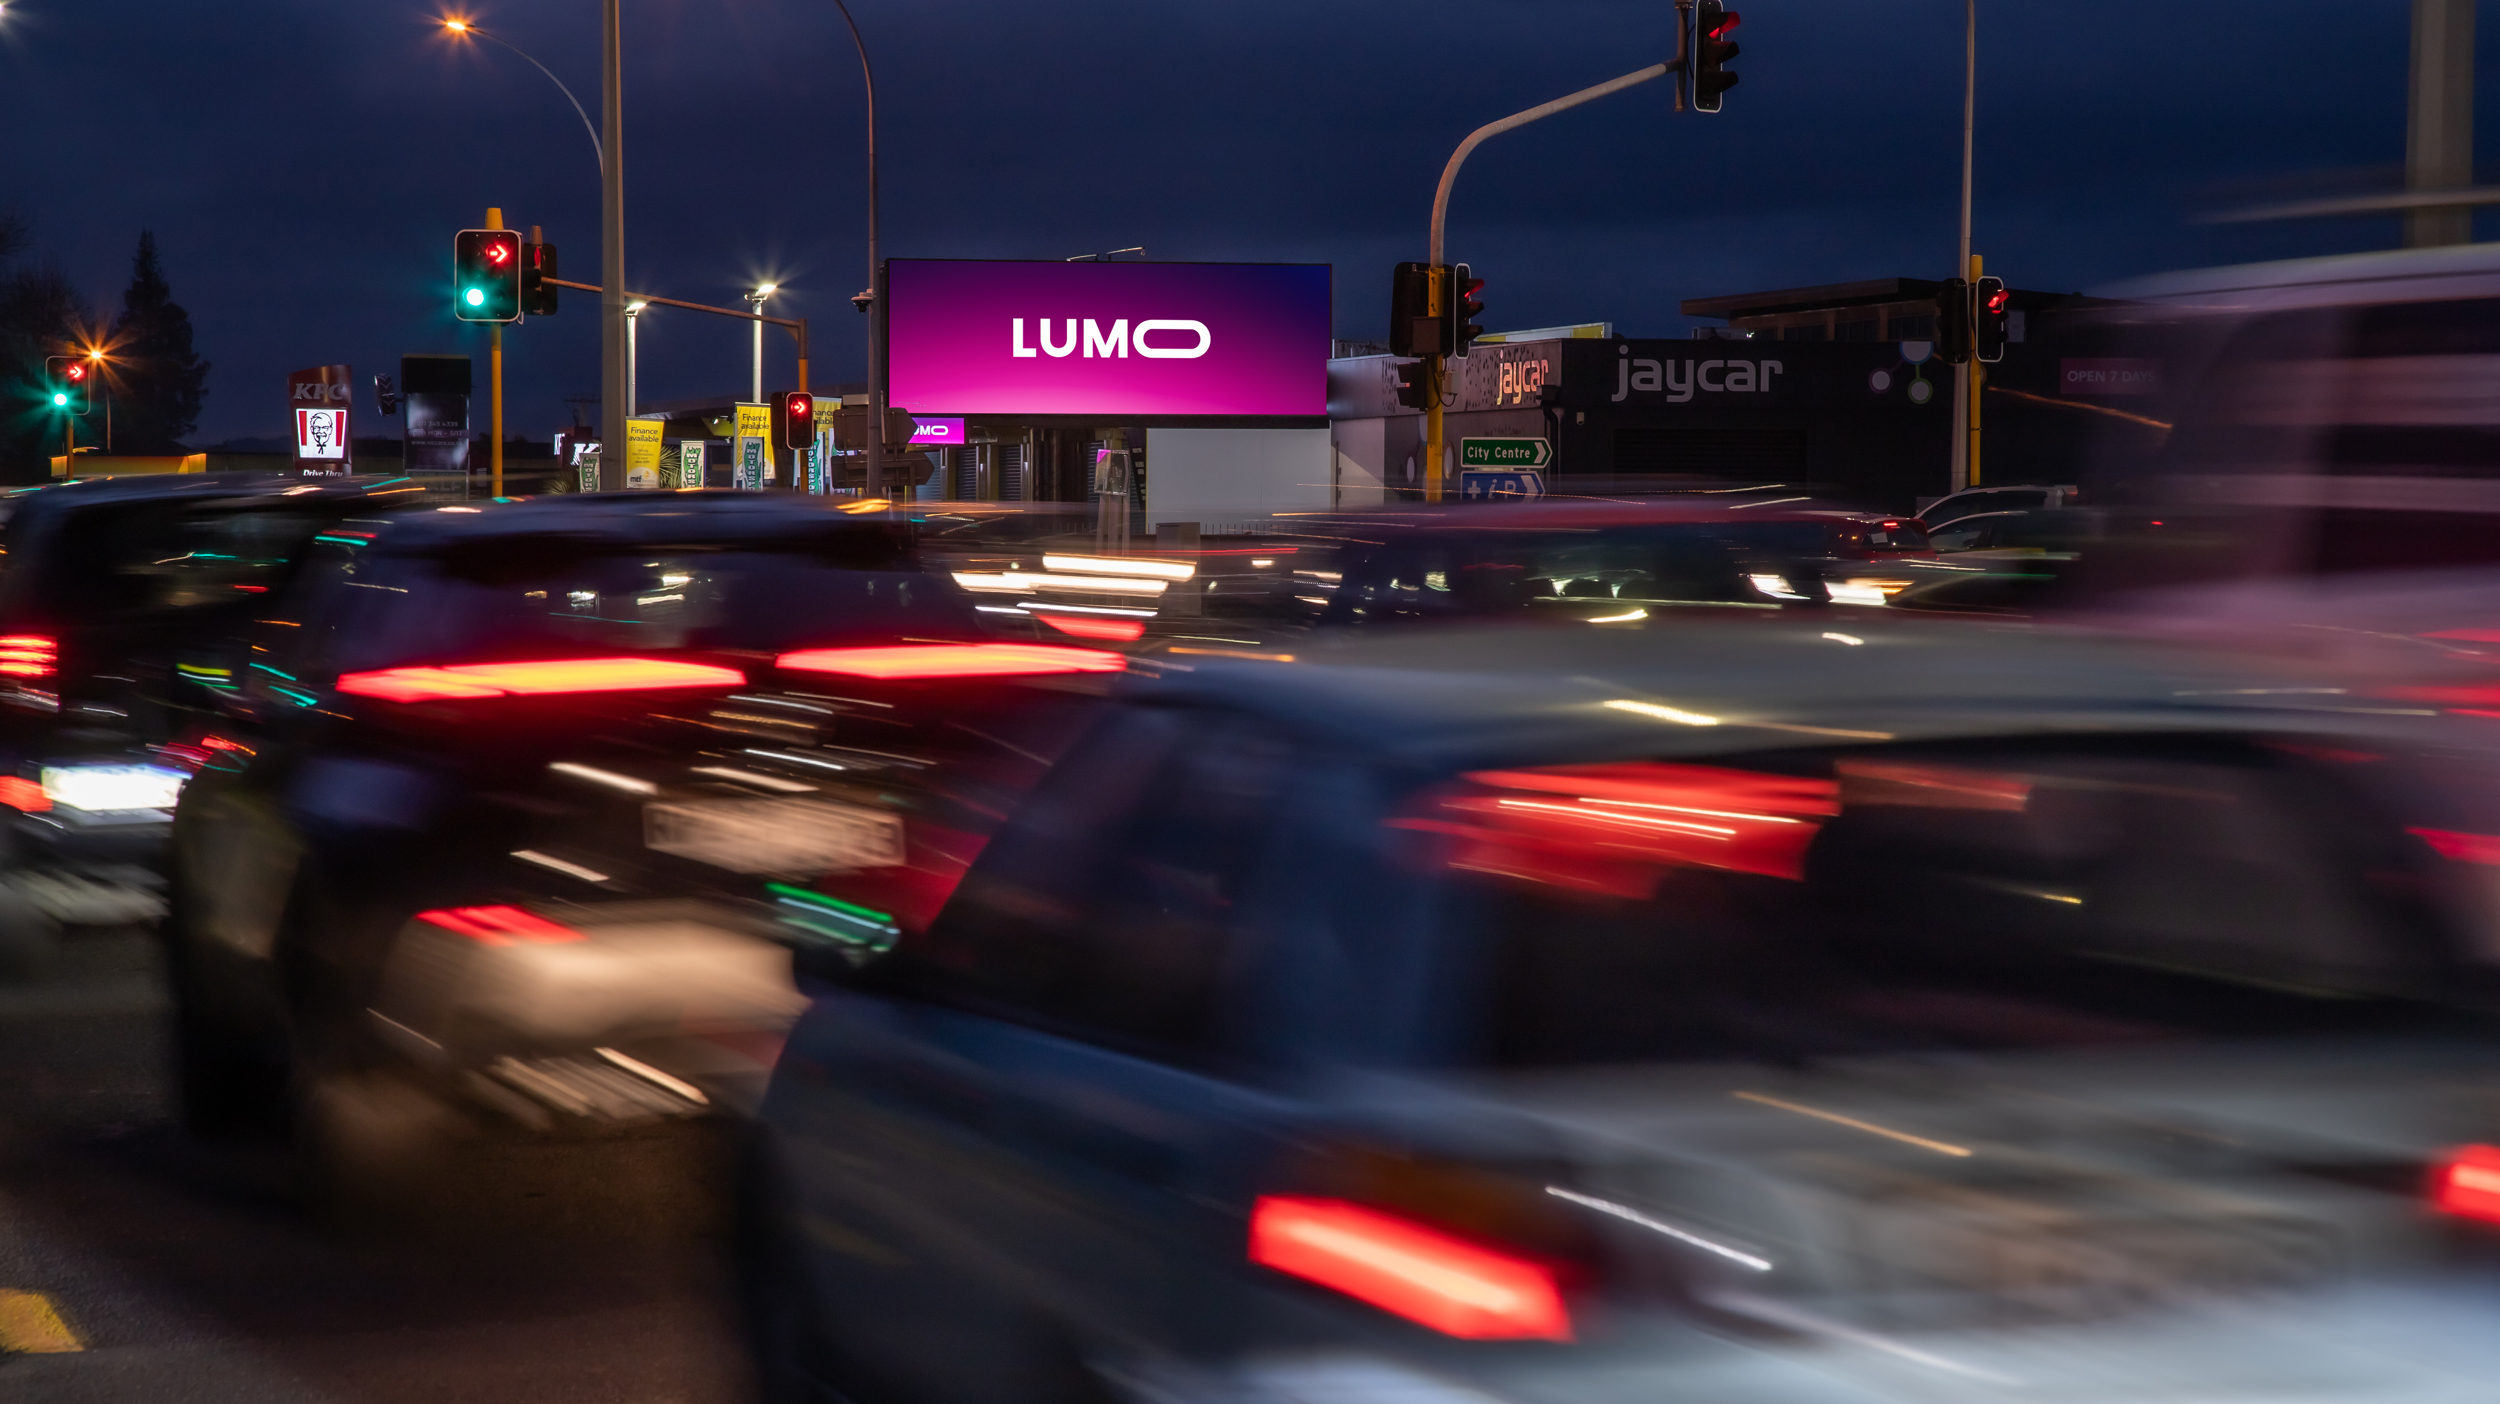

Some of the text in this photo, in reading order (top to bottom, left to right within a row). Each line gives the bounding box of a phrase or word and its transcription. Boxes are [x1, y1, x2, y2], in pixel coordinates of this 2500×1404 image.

[1012, 318, 1211, 359] LUMO
[1496, 348, 1549, 406] jaycar
[1612, 345, 1783, 403] jaycar
[2067, 370, 2156, 383] OPEN 7 DAYS
[293, 383, 343, 400] KFC
[742, 413, 767, 421] Finance
[630, 427, 658, 435] Finance
[741, 422, 769, 430] available
[913, 425, 949, 436] MO
[628, 435, 659, 443] available
[1467, 446, 1530, 460] City Centre
[303, 469, 343, 477] Drive Thru
[630, 475, 642, 483] mtf
